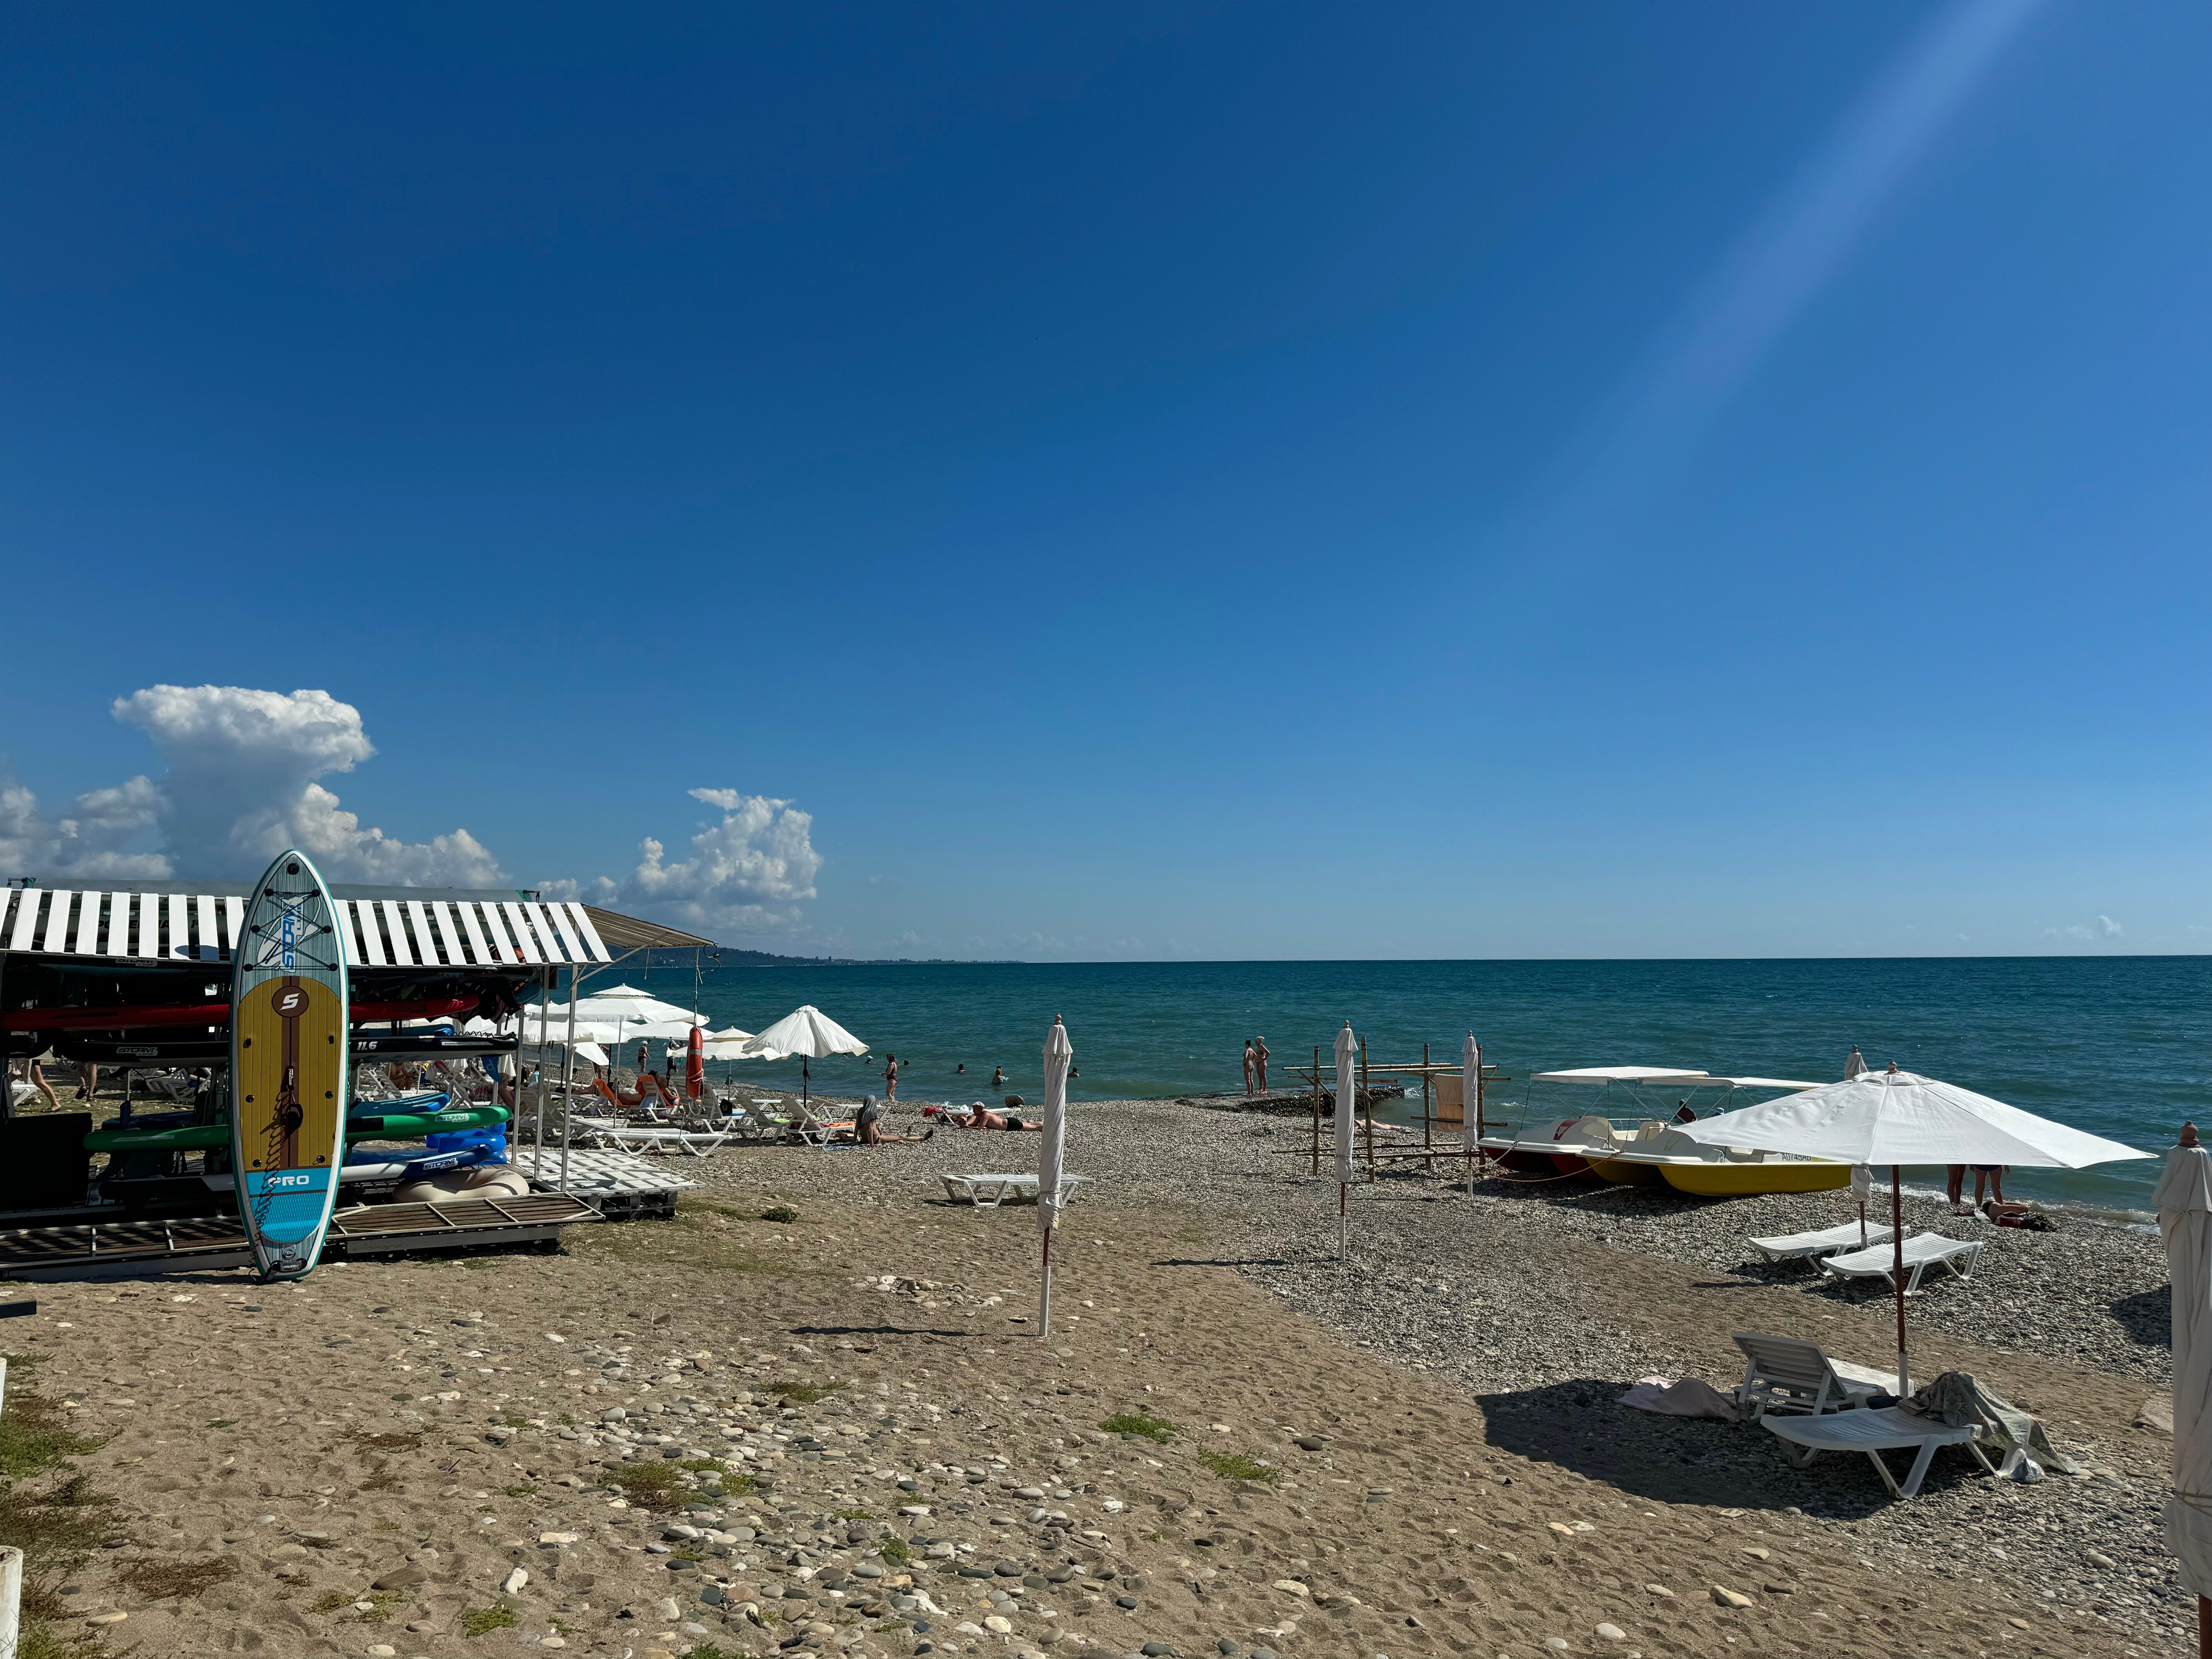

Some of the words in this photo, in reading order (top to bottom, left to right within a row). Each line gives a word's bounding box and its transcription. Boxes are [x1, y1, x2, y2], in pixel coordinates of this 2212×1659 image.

[282, 903, 294, 970] STORM
[279, 993, 301, 1010] S
[357, 1041, 378, 1051] 11.6
[425, 1159, 455, 1168] STORM
[268, 1175, 309, 1187] PRO
